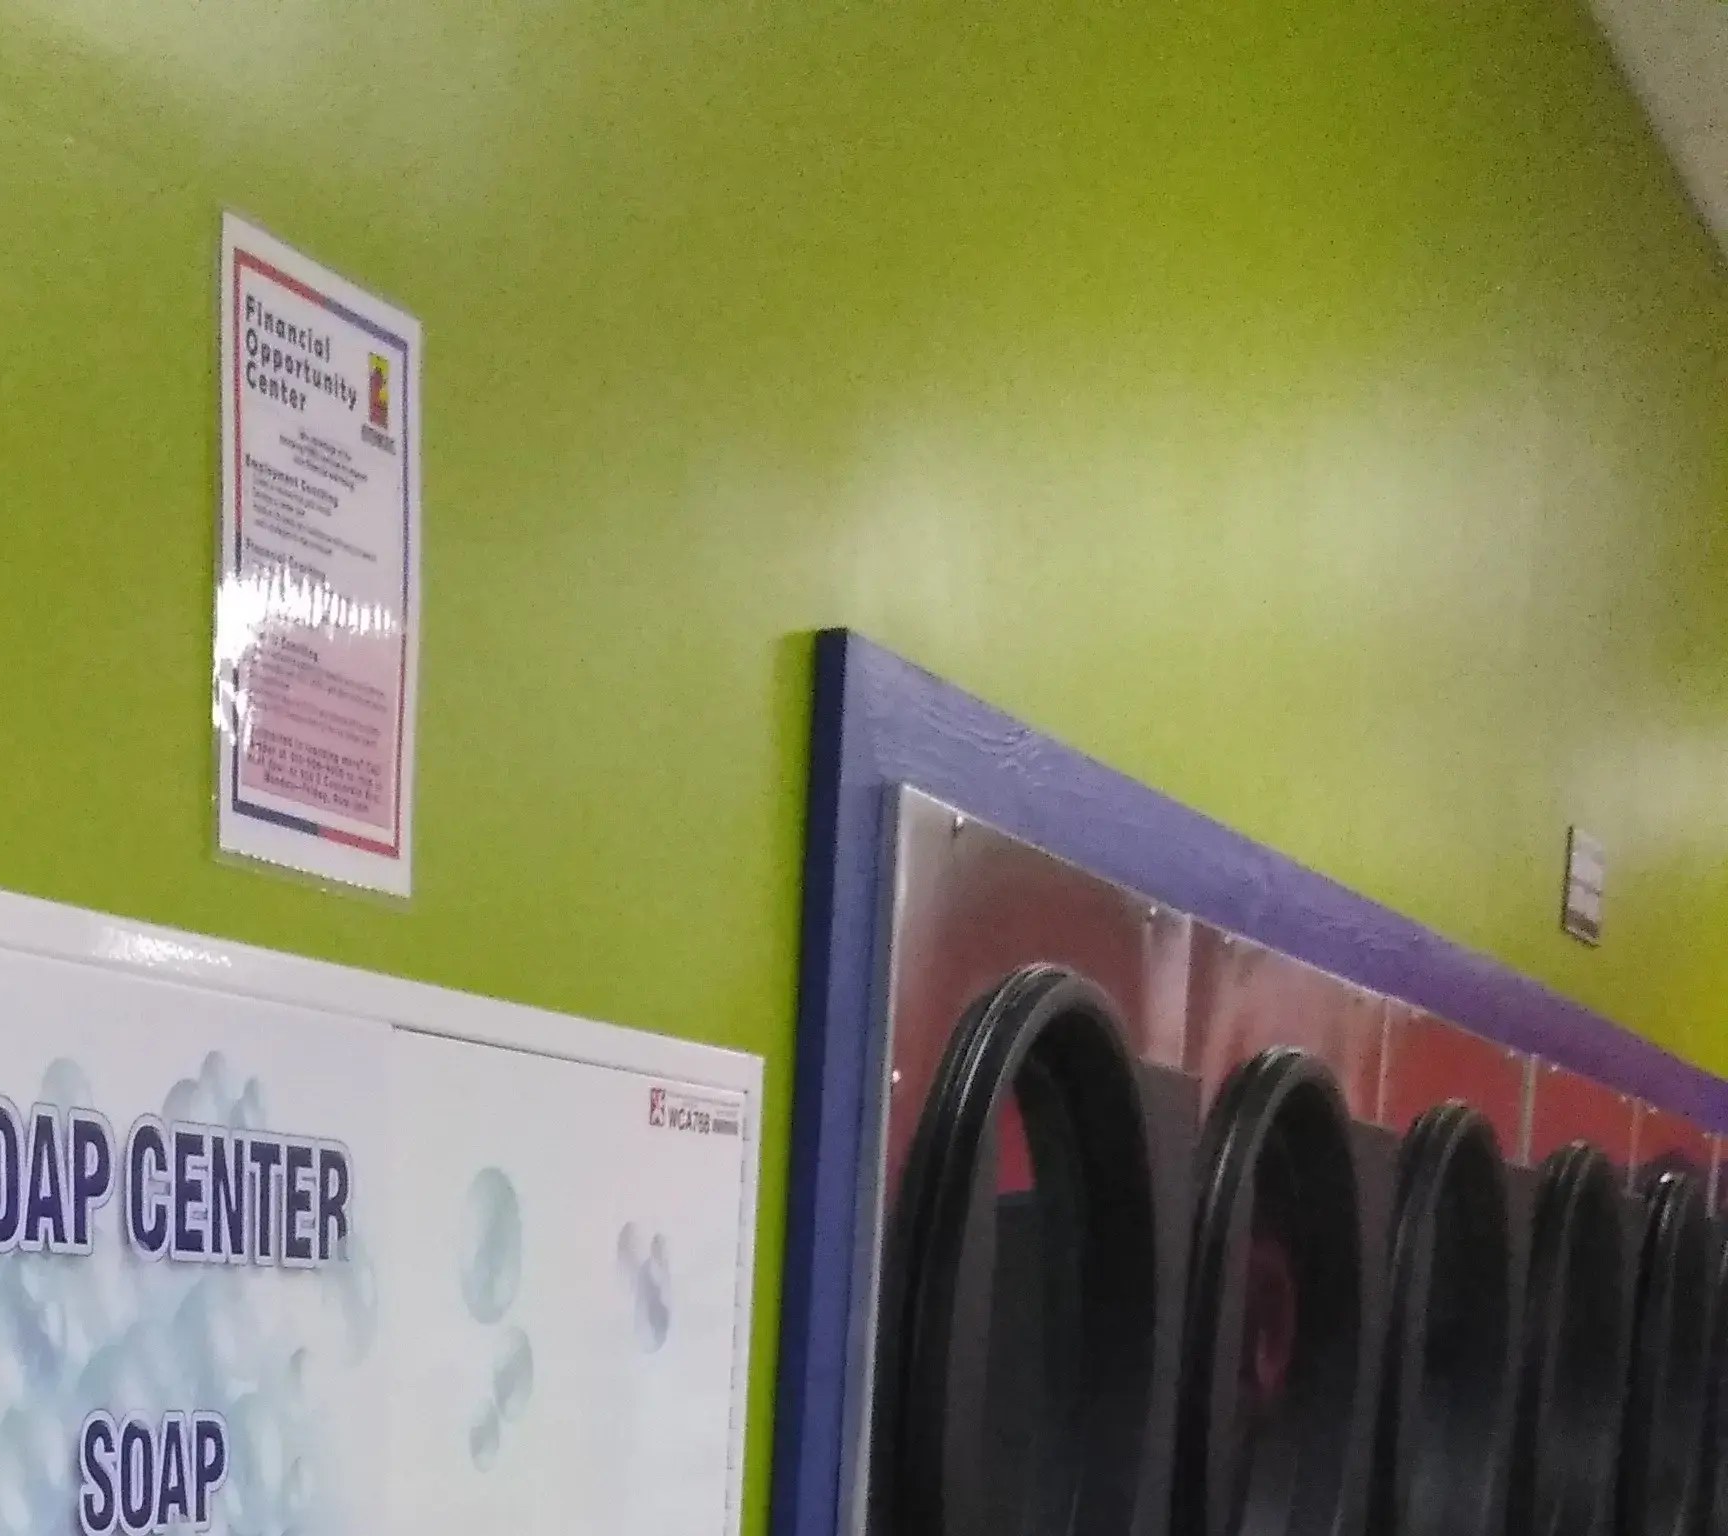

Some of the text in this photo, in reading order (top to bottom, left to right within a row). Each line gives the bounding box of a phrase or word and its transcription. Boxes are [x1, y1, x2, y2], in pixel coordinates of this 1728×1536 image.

[245, 294, 332, 363] Financial
[245, 328, 357, 412] Opportunity
[246, 359, 307, 412] Center
[127, 1114, 352, 1267] CENTER
